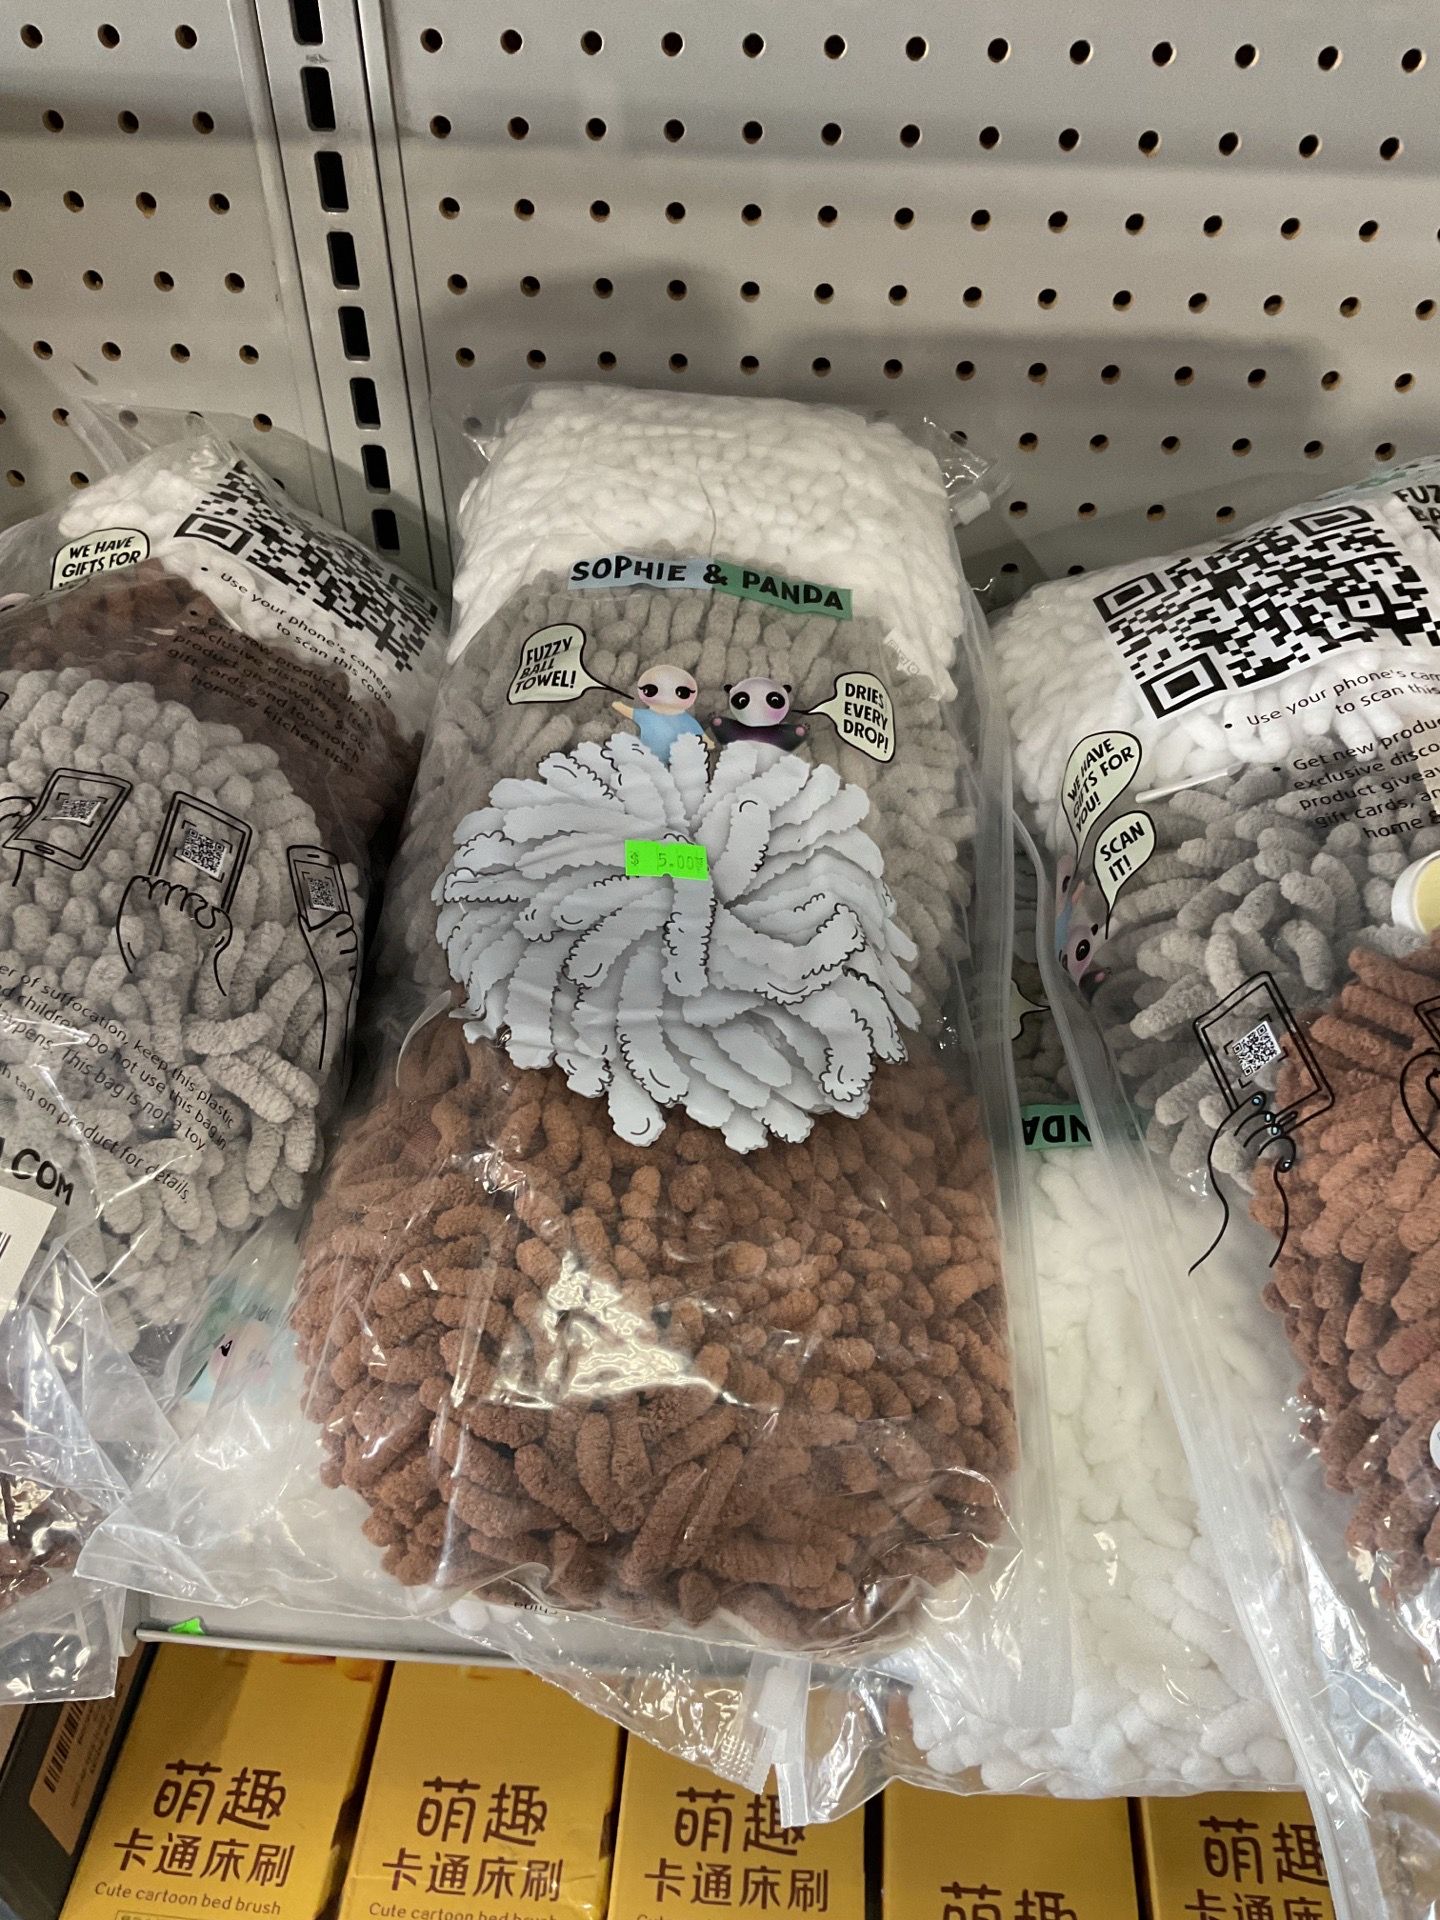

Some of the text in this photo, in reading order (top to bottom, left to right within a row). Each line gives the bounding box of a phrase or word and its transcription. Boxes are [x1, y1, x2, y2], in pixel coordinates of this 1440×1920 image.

[62, 550, 141, 578] GIFTS FOR
[69, 536, 136, 559] WE HAVE
[570, 555, 844, 611] SOPHIE & PANDA
[173, 635, 239, 669] product
[189, 625, 264, 668] exclusive
[220, 572, 393, 700] Use your phone's camera
[276, 622, 291, 637] to
[295, 636, 328, 660] scan
[333, 655, 358, 677] this
[525, 636, 573, 666] FUZZY
[167, 650, 198, 667] gift
[276, 656, 336, 690] product
[519, 656, 556, 680] BALL
[514, 670, 577, 694] TOWEL!
[845, 683, 885, 709] DRIES
[1247, 709, 1282, 726] Use
[1286, 689, 1328, 715] your
[1332, 669, 1407, 697] phone's
[844, 703, 888, 729] EVERY
[1335, 684, 1440, 715] to scan this
[263, 706, 320, 750] kitchen
[843, 719, 890, 753] DROP!
[1067, 738, 1115, 802] WE HAVE
[1293, 754, 1328, 772] Get
[1334, 742, 1374, 761] new
[1073, 746, 1135, 819] GIFTS FOR
[1294, 762, 1386, 790] exclusive
[1075, 791, 1101, 833] YOU!
[1299, 785, 1377, 811] product
[1315, 810, 1350, 828] gift
[1355, 797, 1416, 820] cards,
[1100, 821, 1146, 862] SCAN
[1363, 816, 1425, 839] home
[630, 851, 639, 866] $
[1108, 854, 1132, 882] IT!
[20, 974, 40, 988] of
[41, 983, 129, 1045] suffocation,
[133, 1040, 168, 1072] keep
[172, 1067, 197, 1093] this
[197, 1088, 235, 1129] plastic
[61, 1047, 94, 1076] This
[94, 1067, 125, 1098] bag
[126, 1085, 142, 1105] is
[142, 1099, 170, 1124] not
[173, 1118, 183, 1131] a
[184, 1123, 206, 1152] toy.
[86, 1033, 109, 1054] Do
[111, 1051, 138, 1074] not
[141, 1069, 166, 1094] use
[169, 1089, 193, 1115] this
[195, 1108, 219, 1138] bag
[213, 1134, 227, 1151] in
[15, 1074, 36, 1100] tag
[38, 1097, 57, 1118] on
[56, 1112, 120, 1155] product
[119, 1146, 145, 1168] for
[1021, 1115, 1091, 1145] NDA
[153, 1758, 287, 1831] 萌趣
[416, 1775, 548, 1847] 萌趣
[113, 1827, 296, 1888] 卡通床刷
[382, 1847, 564, 1902] 卡通床刷
[94, 1880, 281, 1916] Cute cartoon bed brush
[644, 1858, 829, 1913] 卡通床刷
[369, 1902, 407, 1919] Cute
